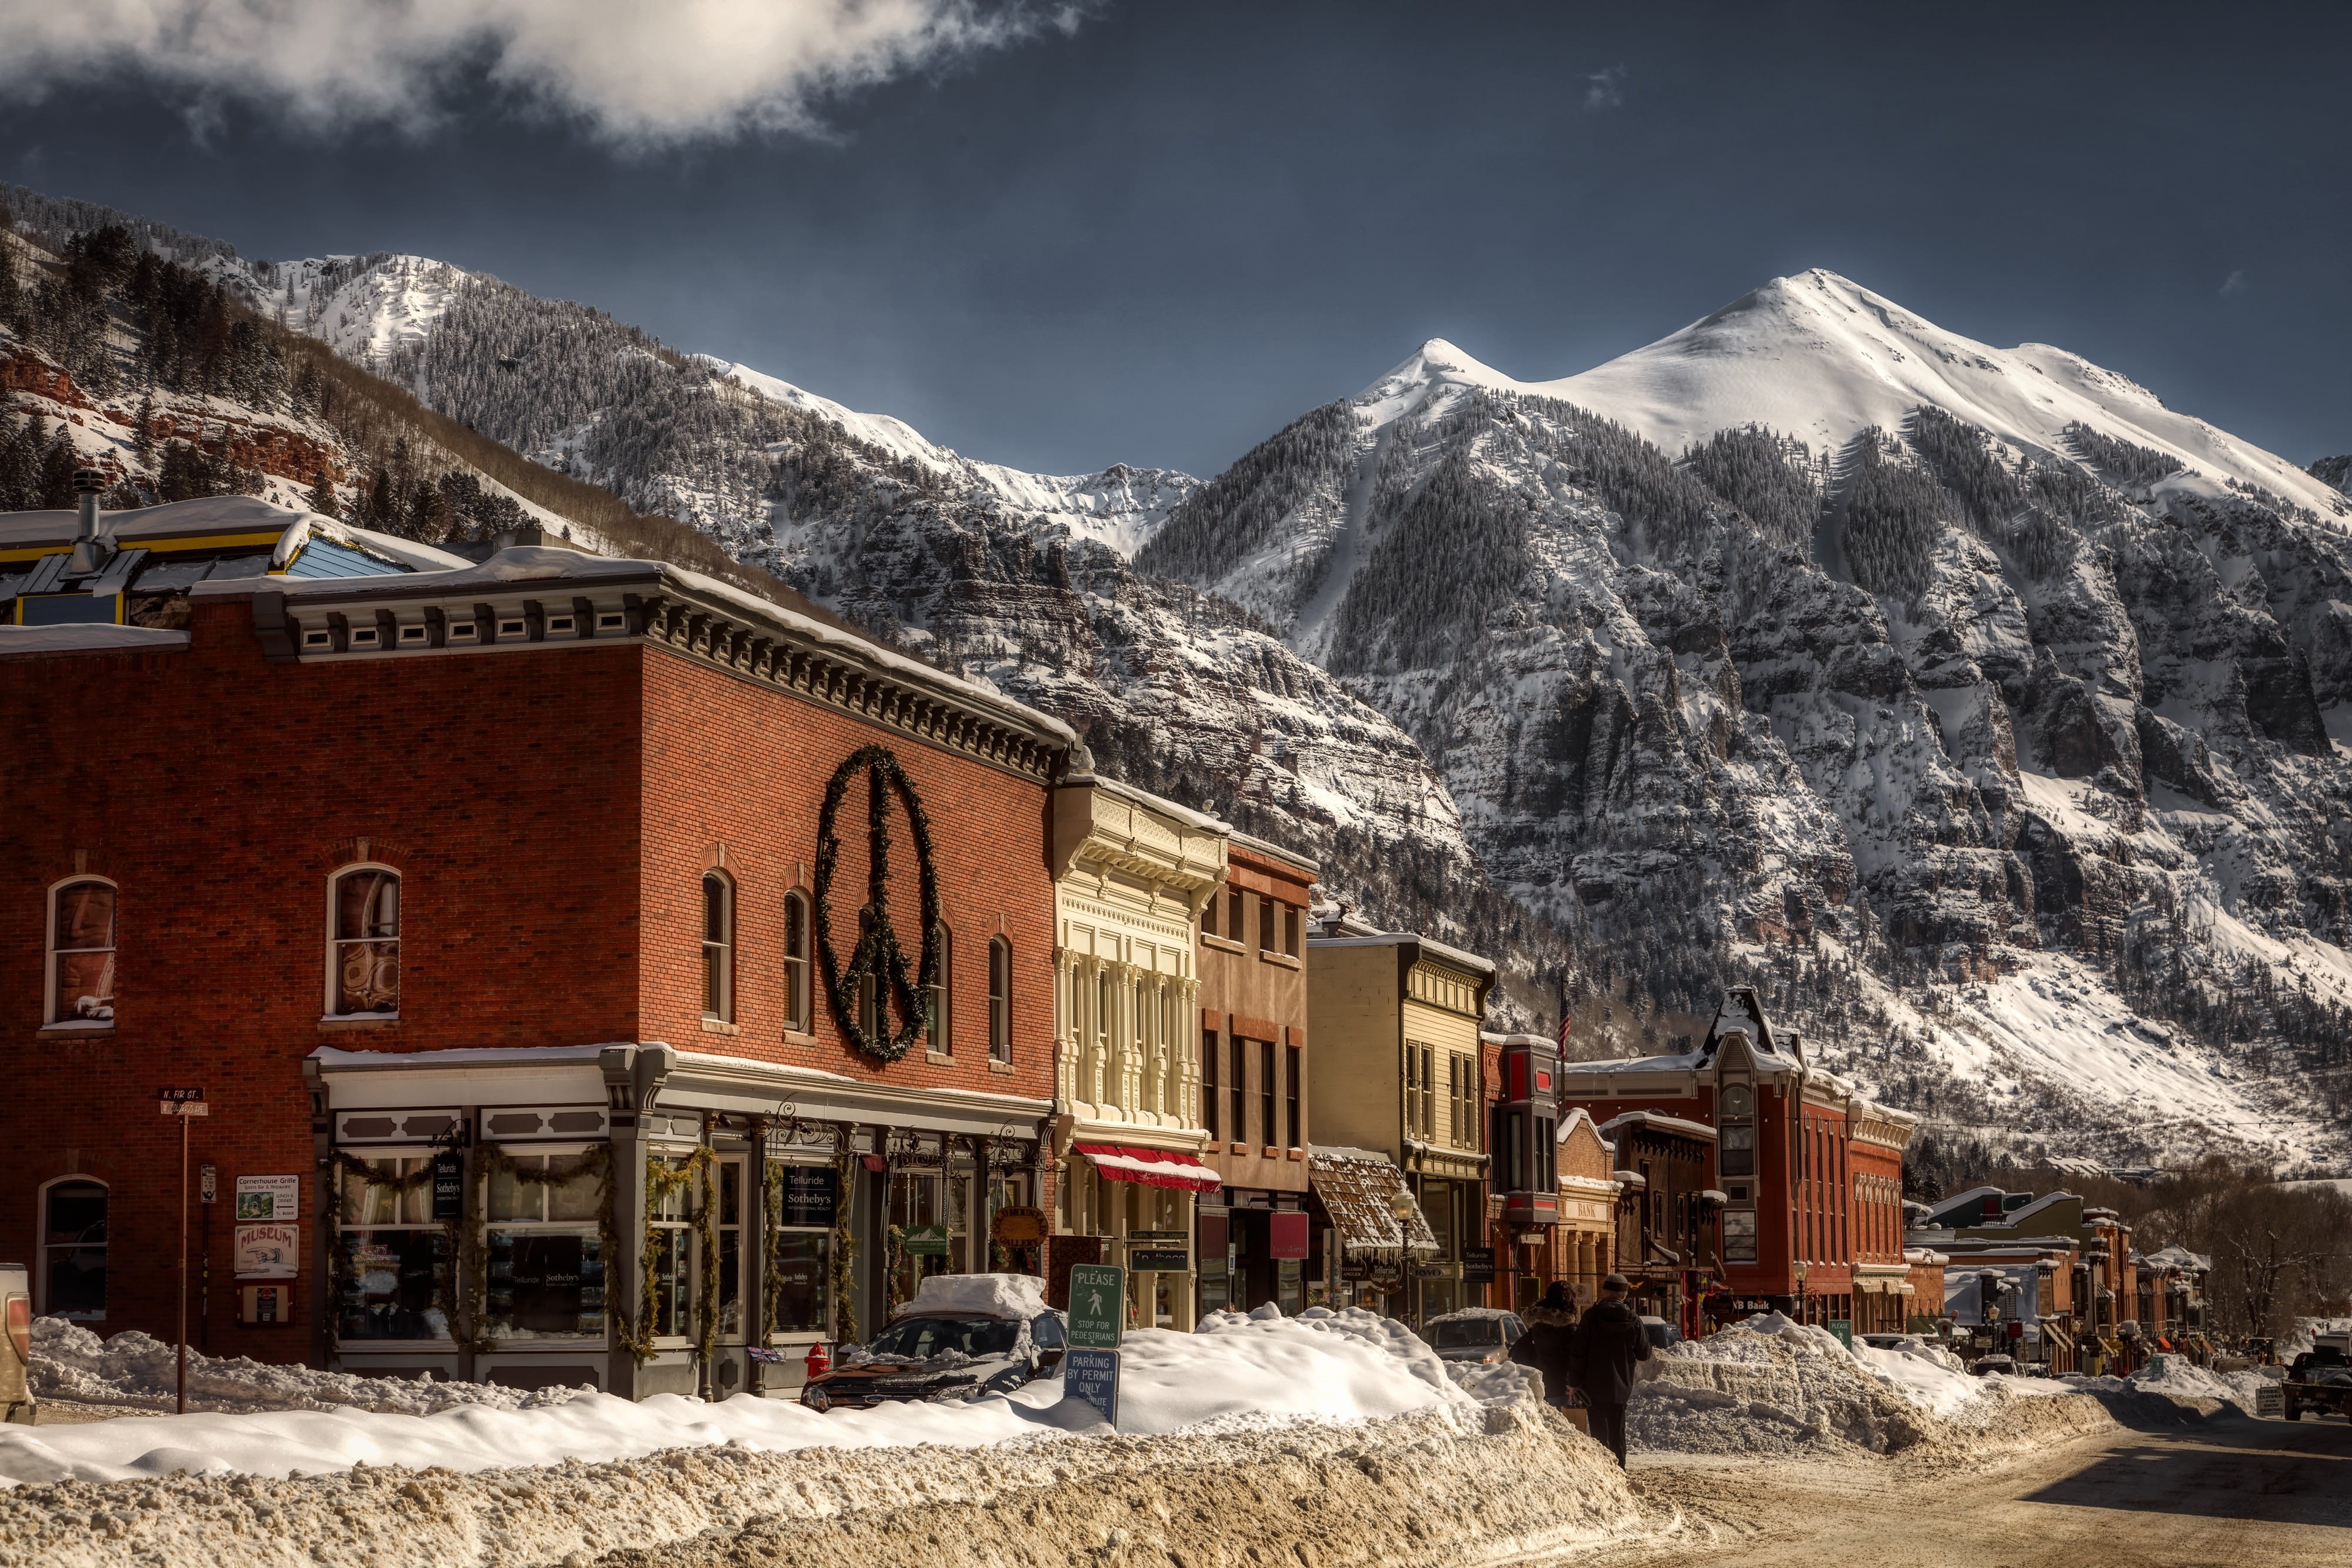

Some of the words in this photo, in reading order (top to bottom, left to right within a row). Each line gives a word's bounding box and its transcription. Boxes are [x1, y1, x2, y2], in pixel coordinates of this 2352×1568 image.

[164, 1090, 171, 1099] N.
[174, 1090, 185, 1099] FIR
[187, 1090, 198, 1099] ST.
[171, 1103, 194, 1113] COLORADO
[437, 1164, 457, 1173] Telluride
[789, 1175, 824, 1185] Telluride
[437, 1182, 460, 1195] Sotheby's
[788, 1193, 831, 1206] Sotheby's
[1578, 1203, 1595, 1217] BANK
[993, 1209, 1008, 1233] GOLD
[1010, 1209, 1046, 1236] MOUNTAIN
[241, 1227, 292, 1249] MUSEUM
[1000, 1236, 1037, 1247] GALLERY
[1374, 1265, 1397, 1275] Telluride
[1466, 1262, 1493, 1270] Sotheby's
[513, 1275, 541, 1283] Telluride
[546, 1273, 579, 1283] Sotheby's
[1078, 1272, 1115, 1286] PLEASE
[1747, 1300, 1770, 1310] Bank
[1077, 1320, 1095, 1329] STOP
[1096, 1321, 1110, 1330] FOR
[1071, 1330, 1115, 1342] PEDESTRIANS
[1073, 1356, 1110, 1369] PARKING
[1067, 1369, 1079, 1379] BY
[1082, 1369, 1114, 1382] PERMIT
[1079, 1382, 1100, 1393] ONLY
